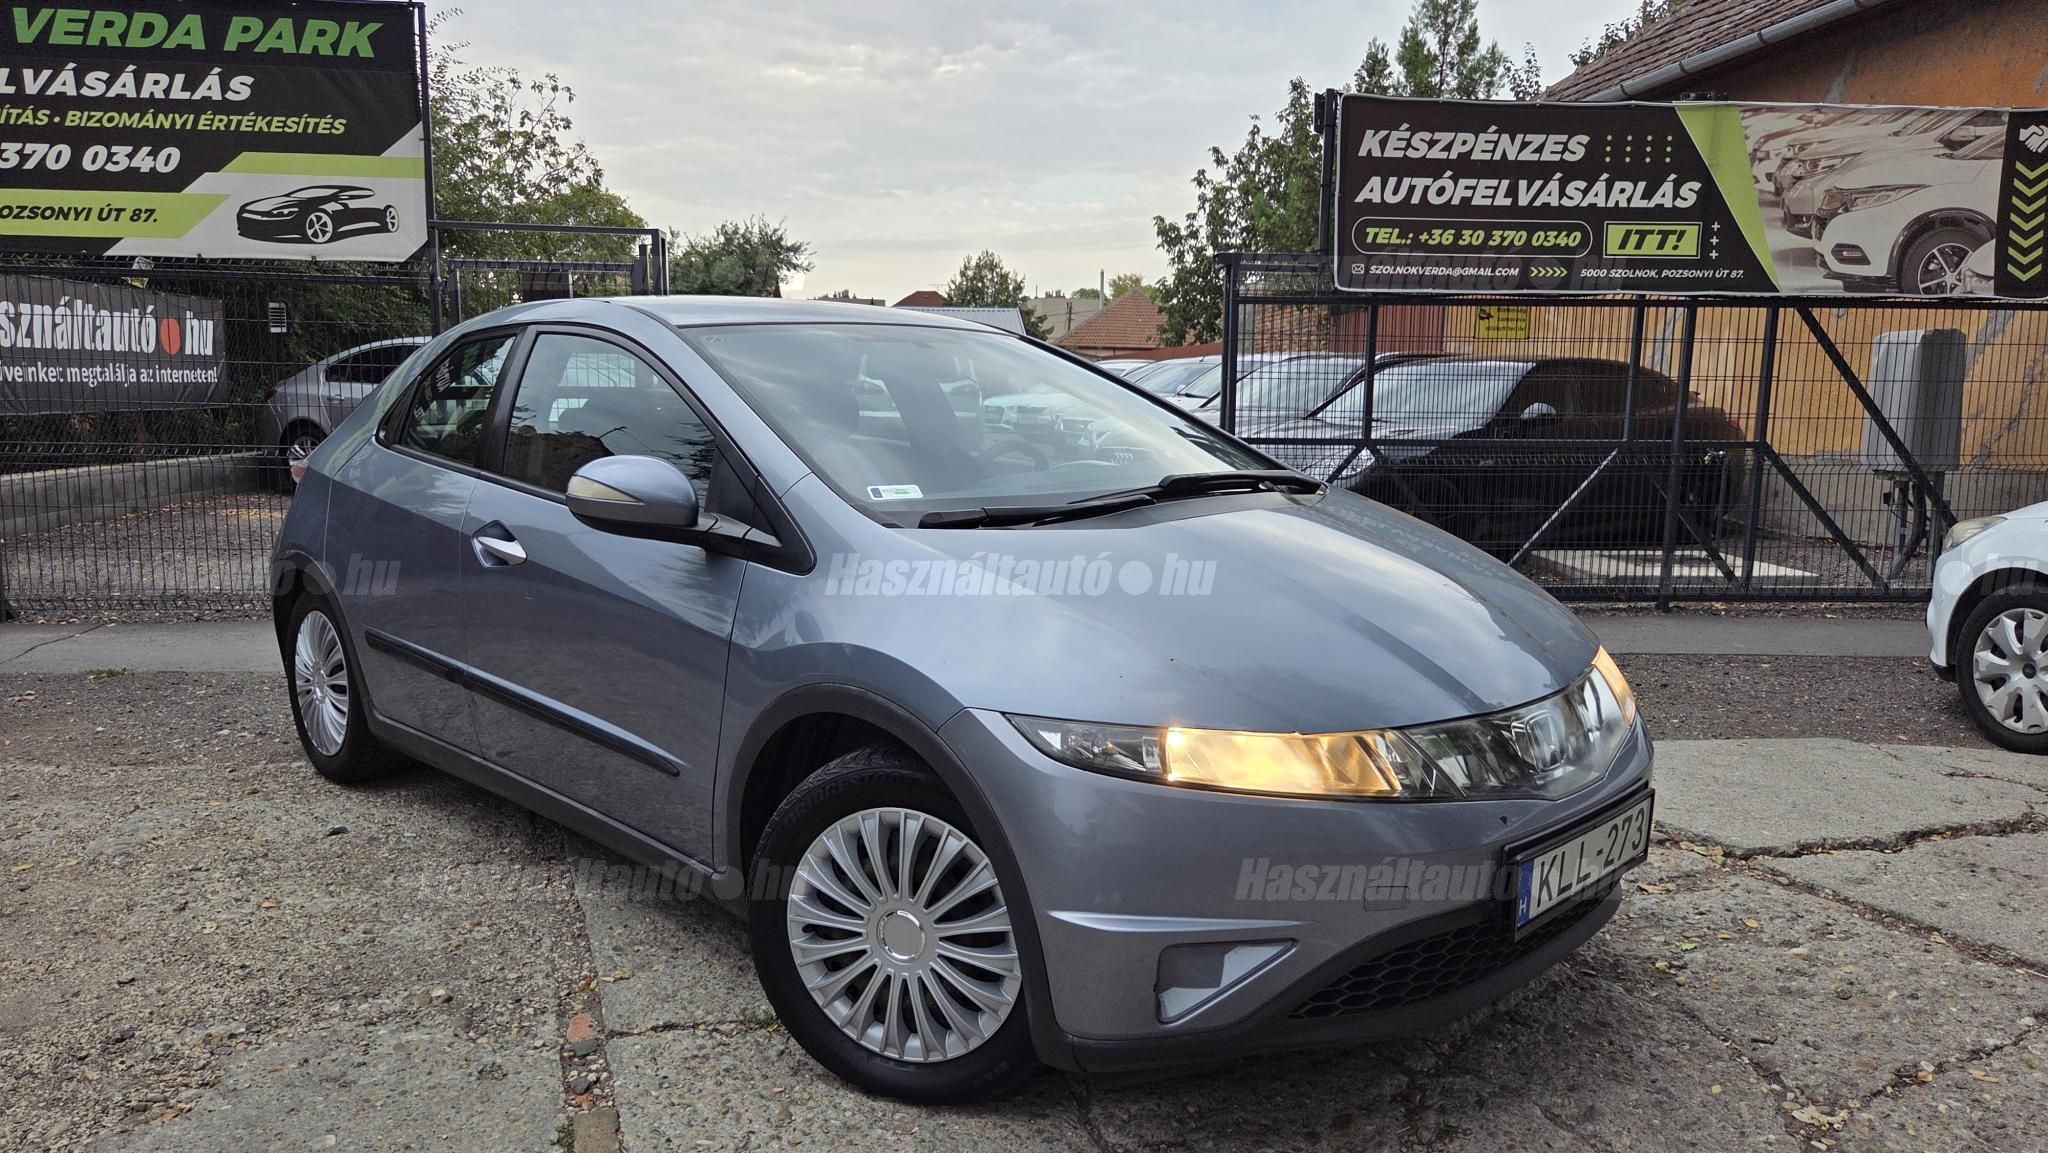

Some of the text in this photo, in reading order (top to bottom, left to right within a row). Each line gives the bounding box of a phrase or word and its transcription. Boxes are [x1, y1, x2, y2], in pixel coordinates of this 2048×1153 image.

[12, 7, 384, 58] VERDA PARK
[0, 62, 256, 101] LVÁSÁRLÁS
[0, 104, 347, 136] ÍTÁS BIZOMÁNYI ÉRTÉKESÍTÉS
[0, 142, 181, 173] 370 0340
[1357, 123, 1591, 162] KÉSZPÉNZES
[1355, 169, 1702, 209] AUTÓFELVÁSÁRLÁS
[0, 203, 158, 223] OZSONYI ÚT 87.
[1365, 227, 1582, 248] TEL.: +36 30 370 0340
[1617, 228, 1688, 251] ITT!
[1369, 264, 1520, 277] SZOLNOKVERDA@GMAIL.COM
[1580, 267, 1744, 279] 5000 SZOLNOK, POZSONYI ÚT 87.
[185, 310, 214, 356] hu
[0, 361, 64, 383] veinket
[67, 363, 137, 388] megtalálja
[156, 364, 218, 383] interneten!
[1536, 807, 1645, 909] KLL-273
[1518, 898, 1527, 917] H
